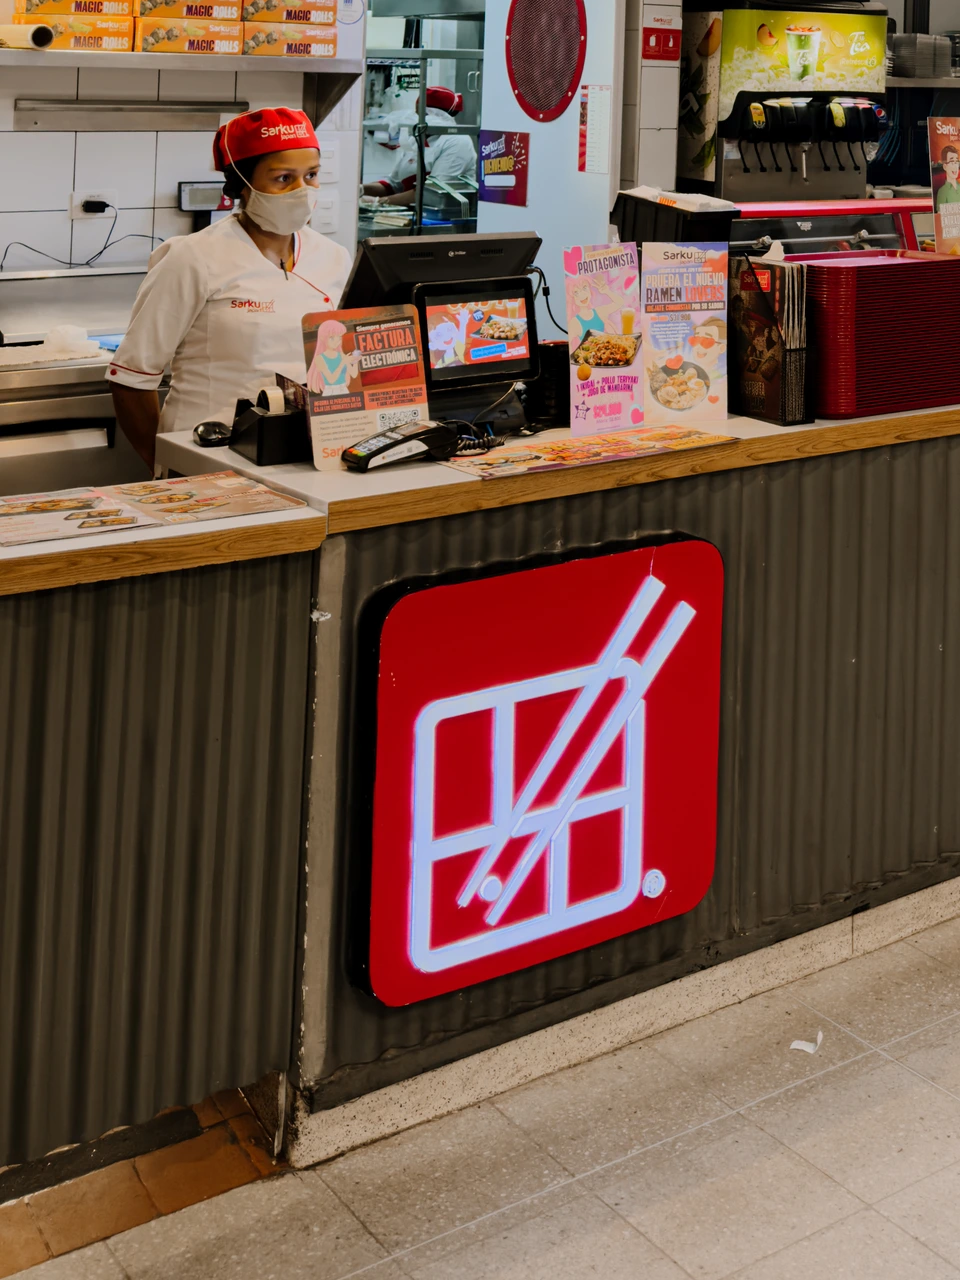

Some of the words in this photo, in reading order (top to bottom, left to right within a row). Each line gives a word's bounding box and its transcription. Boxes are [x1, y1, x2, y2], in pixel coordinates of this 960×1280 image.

[74, 1, 103, 14] MAGIC
[103, 1, 128, 15] ROLLS
[186, 5, 213, 17] MAGIC
[213, 5, 237, 18] ROLLS
[285, 9, 311, 21] MAGIC
[311, 11, 334, 22] ROLLS
[73, 36, 102, 48] MAGIC
[102, 37, 128, 50] ROLLS
[187, 39, 214, 51] MAGIC
[214, 40, 239, 52] ROLLS
[286, 43, 311, 55] MAGIC
[311, 44, 334, 56] ROLLS
[261, 124, 295, 138] Sarku
[935, 122, 958, 135] Sarku
[481, 141, 499, 156] Sarku
[663, 251, 693, 260] Sarku
[577, 252, 635, 275] PROTAGONISTA
[645, 273, 680, 288] PRUEBA
[683, 273, 693, 287] EL
[696, 272, 724, 286] NUEVO
[646, 287, 682, 303] RAMEN
[685, 285, 725, 302] LOVERS
[230, 299, 261, 308] Sarku
[356, 324, 379, 332] Siempre
[358, 328, 414, 352] FACTURA
[361, 348, 417, 369] ELECTRÓNICA
